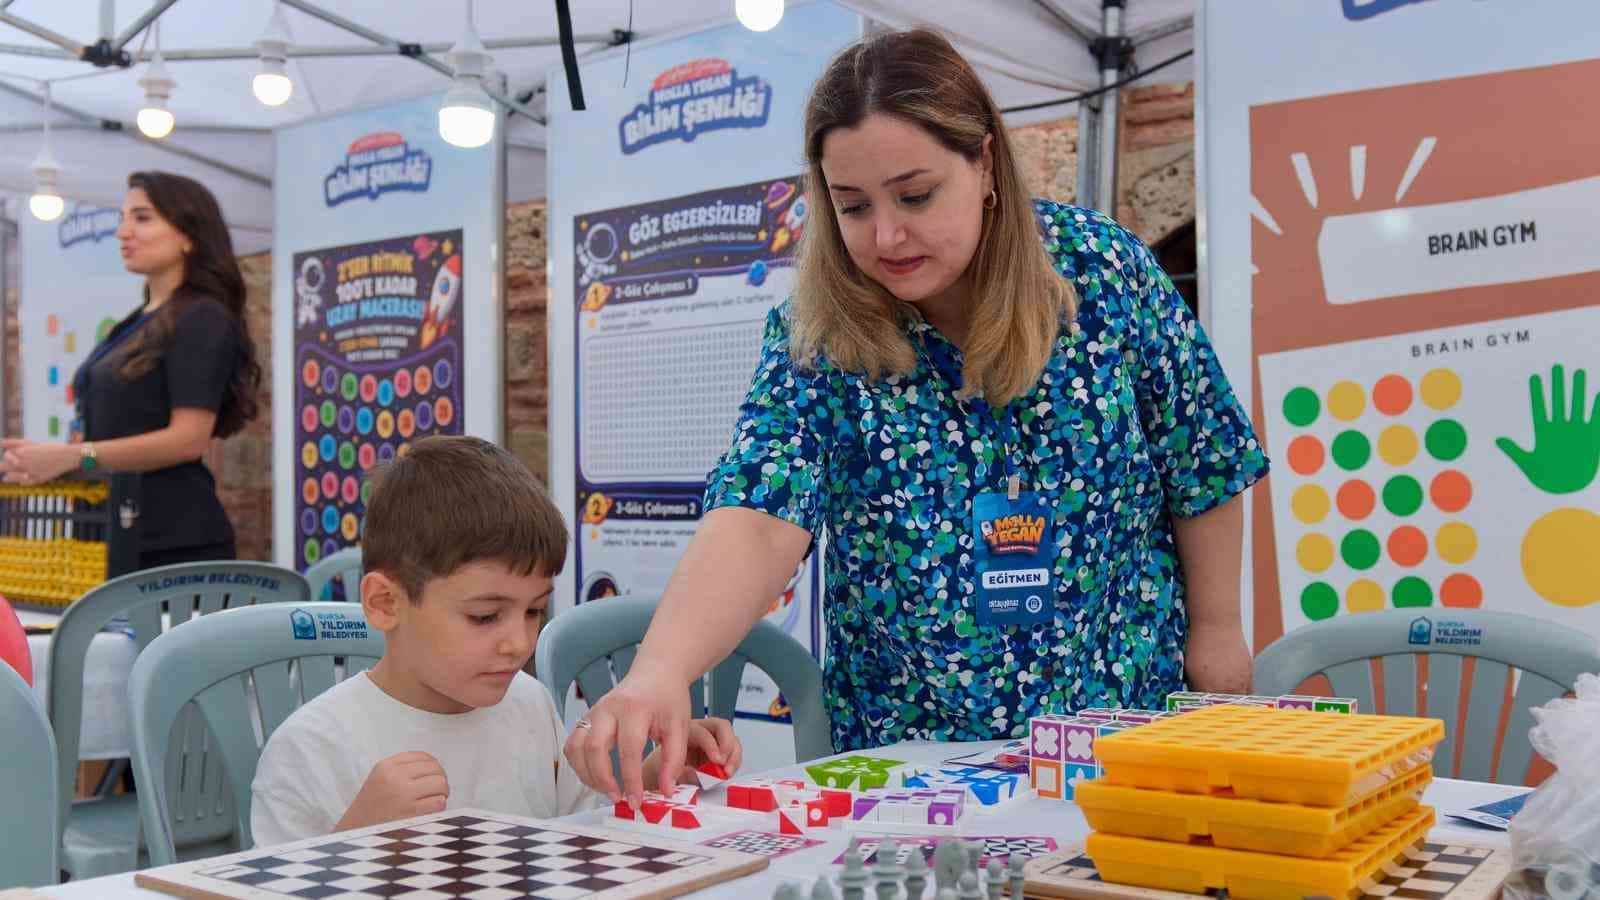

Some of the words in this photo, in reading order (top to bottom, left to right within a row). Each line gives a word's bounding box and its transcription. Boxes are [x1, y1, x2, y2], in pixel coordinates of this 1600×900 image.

[624, 103, 681, 146] BİLİM
[628, 214, 661, 245] GÖZ
[662, 199, 762, 231] EGZERSİZLERİ
[1428, 228, 1488, 256] BRAIN
[1493, 220, 1537, 247] GYM
[1411, 338, 1474, 357] BRAIN
[1486, 330, 1530, 347] GYM
[994, 514, 1046, 530] MOLLA
[988, 573, 1041, 585] EĞİTMEN
[319, 620, 367, 630] YILDIRIM
